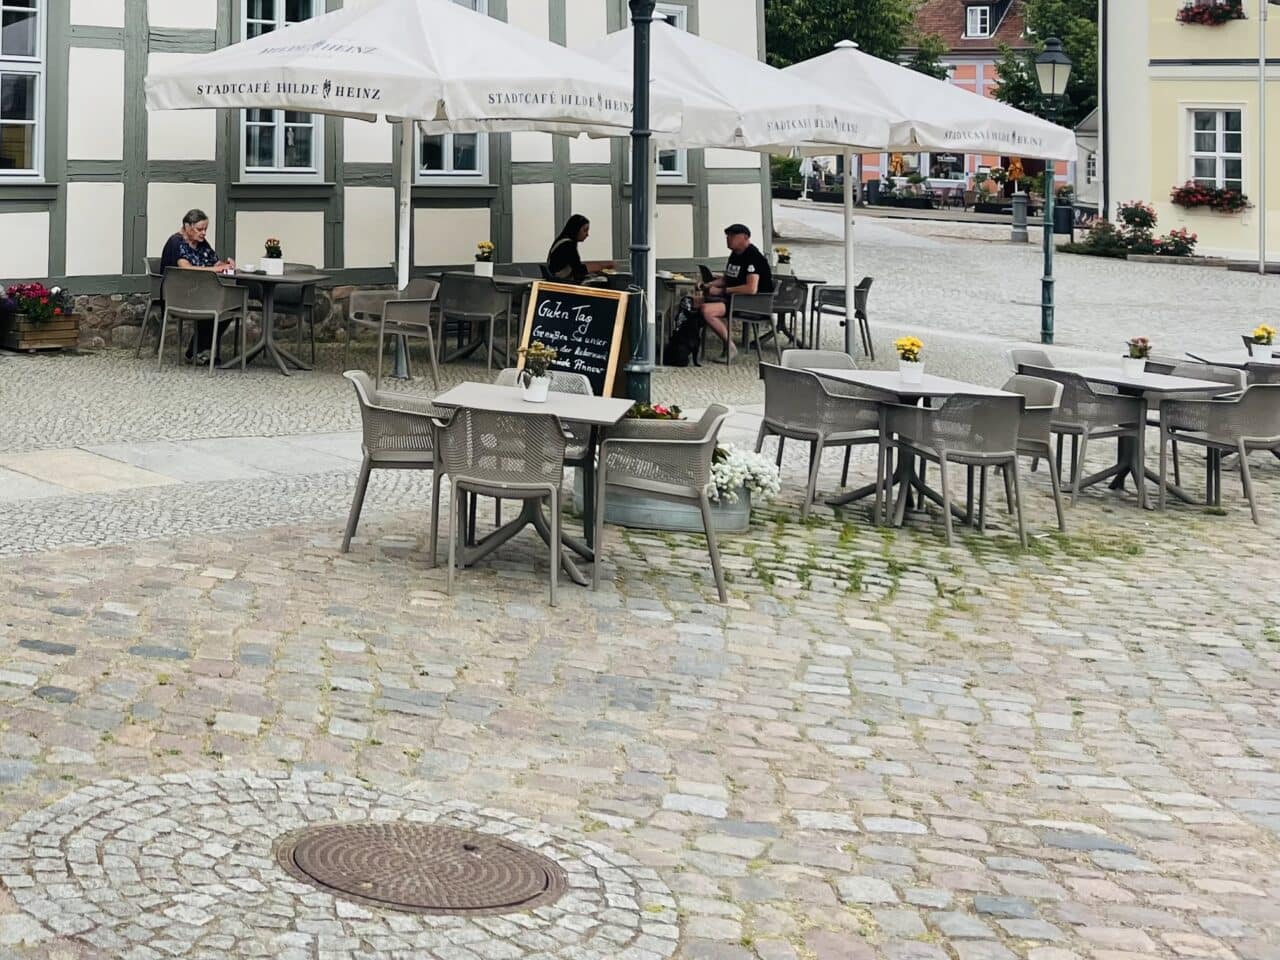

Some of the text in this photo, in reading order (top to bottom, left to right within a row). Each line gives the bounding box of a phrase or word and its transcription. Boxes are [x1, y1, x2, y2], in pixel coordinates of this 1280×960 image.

[197, 81, 380, 100] STADTCAFÉ HILDE HEINZ
[488, 91, 556, 105] STADTCAFÉ
[561, 94, 594, 107] HILDE
[538, 299, 593, 334] Guten Tag
